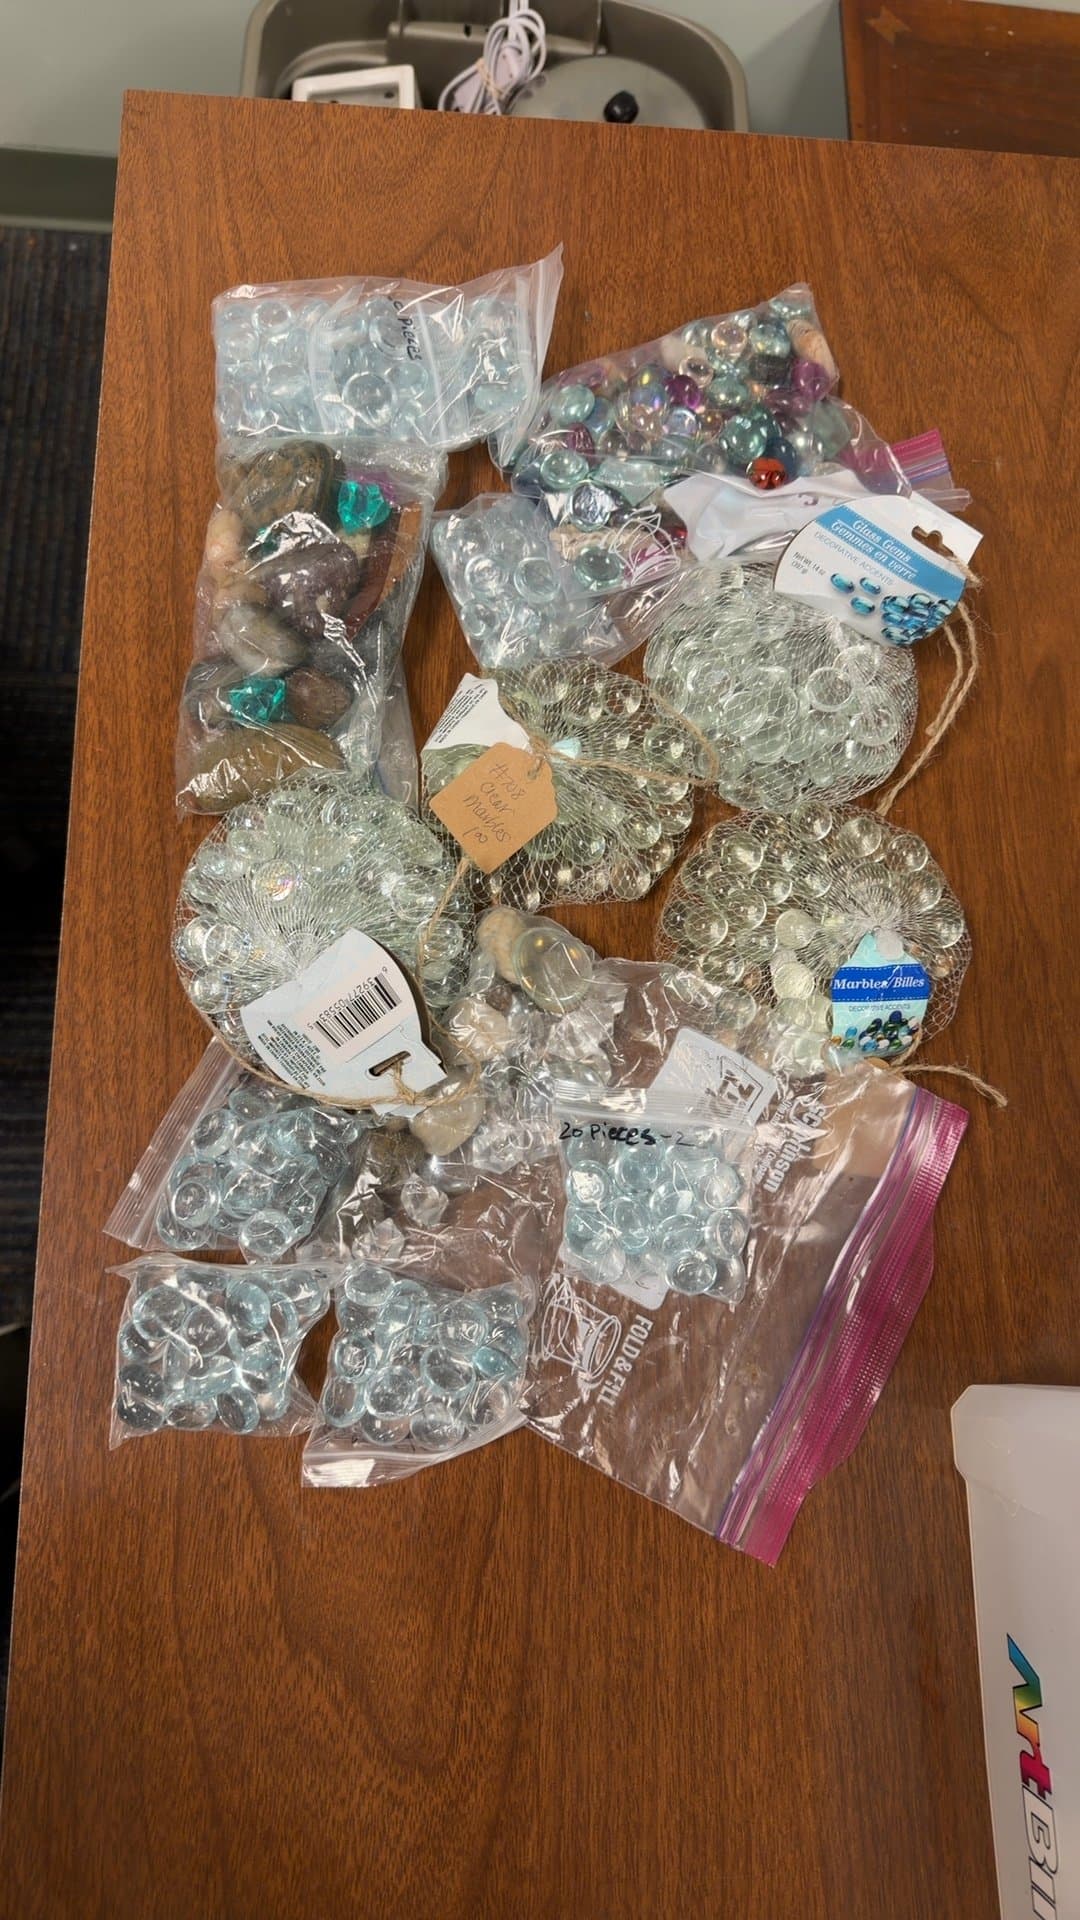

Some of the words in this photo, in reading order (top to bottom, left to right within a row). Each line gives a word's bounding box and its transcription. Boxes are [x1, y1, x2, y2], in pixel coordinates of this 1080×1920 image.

[831, 521, 875, 554] Gemmes
[873, 550, 889, 563] en
[888, 559, 917, 580] verre
[852, 519, 883, 543] Glass
[882, 539, 912, 562] Gems
[814, 531, 858, 562] DECORATIVE
[860, 560, 894, 587] ACCENTS
[480, 782, 513, 813] Clear
[347, 976, 376, 1002] 39277
[318, 998, 347, 1023] 05583
[558, 1121, 583, 1140] 20
[621, 1314, 654, 1360] FOLD
[613, 1356, 633, 1373] &
[597, 1369, 627, 1407] FILL
